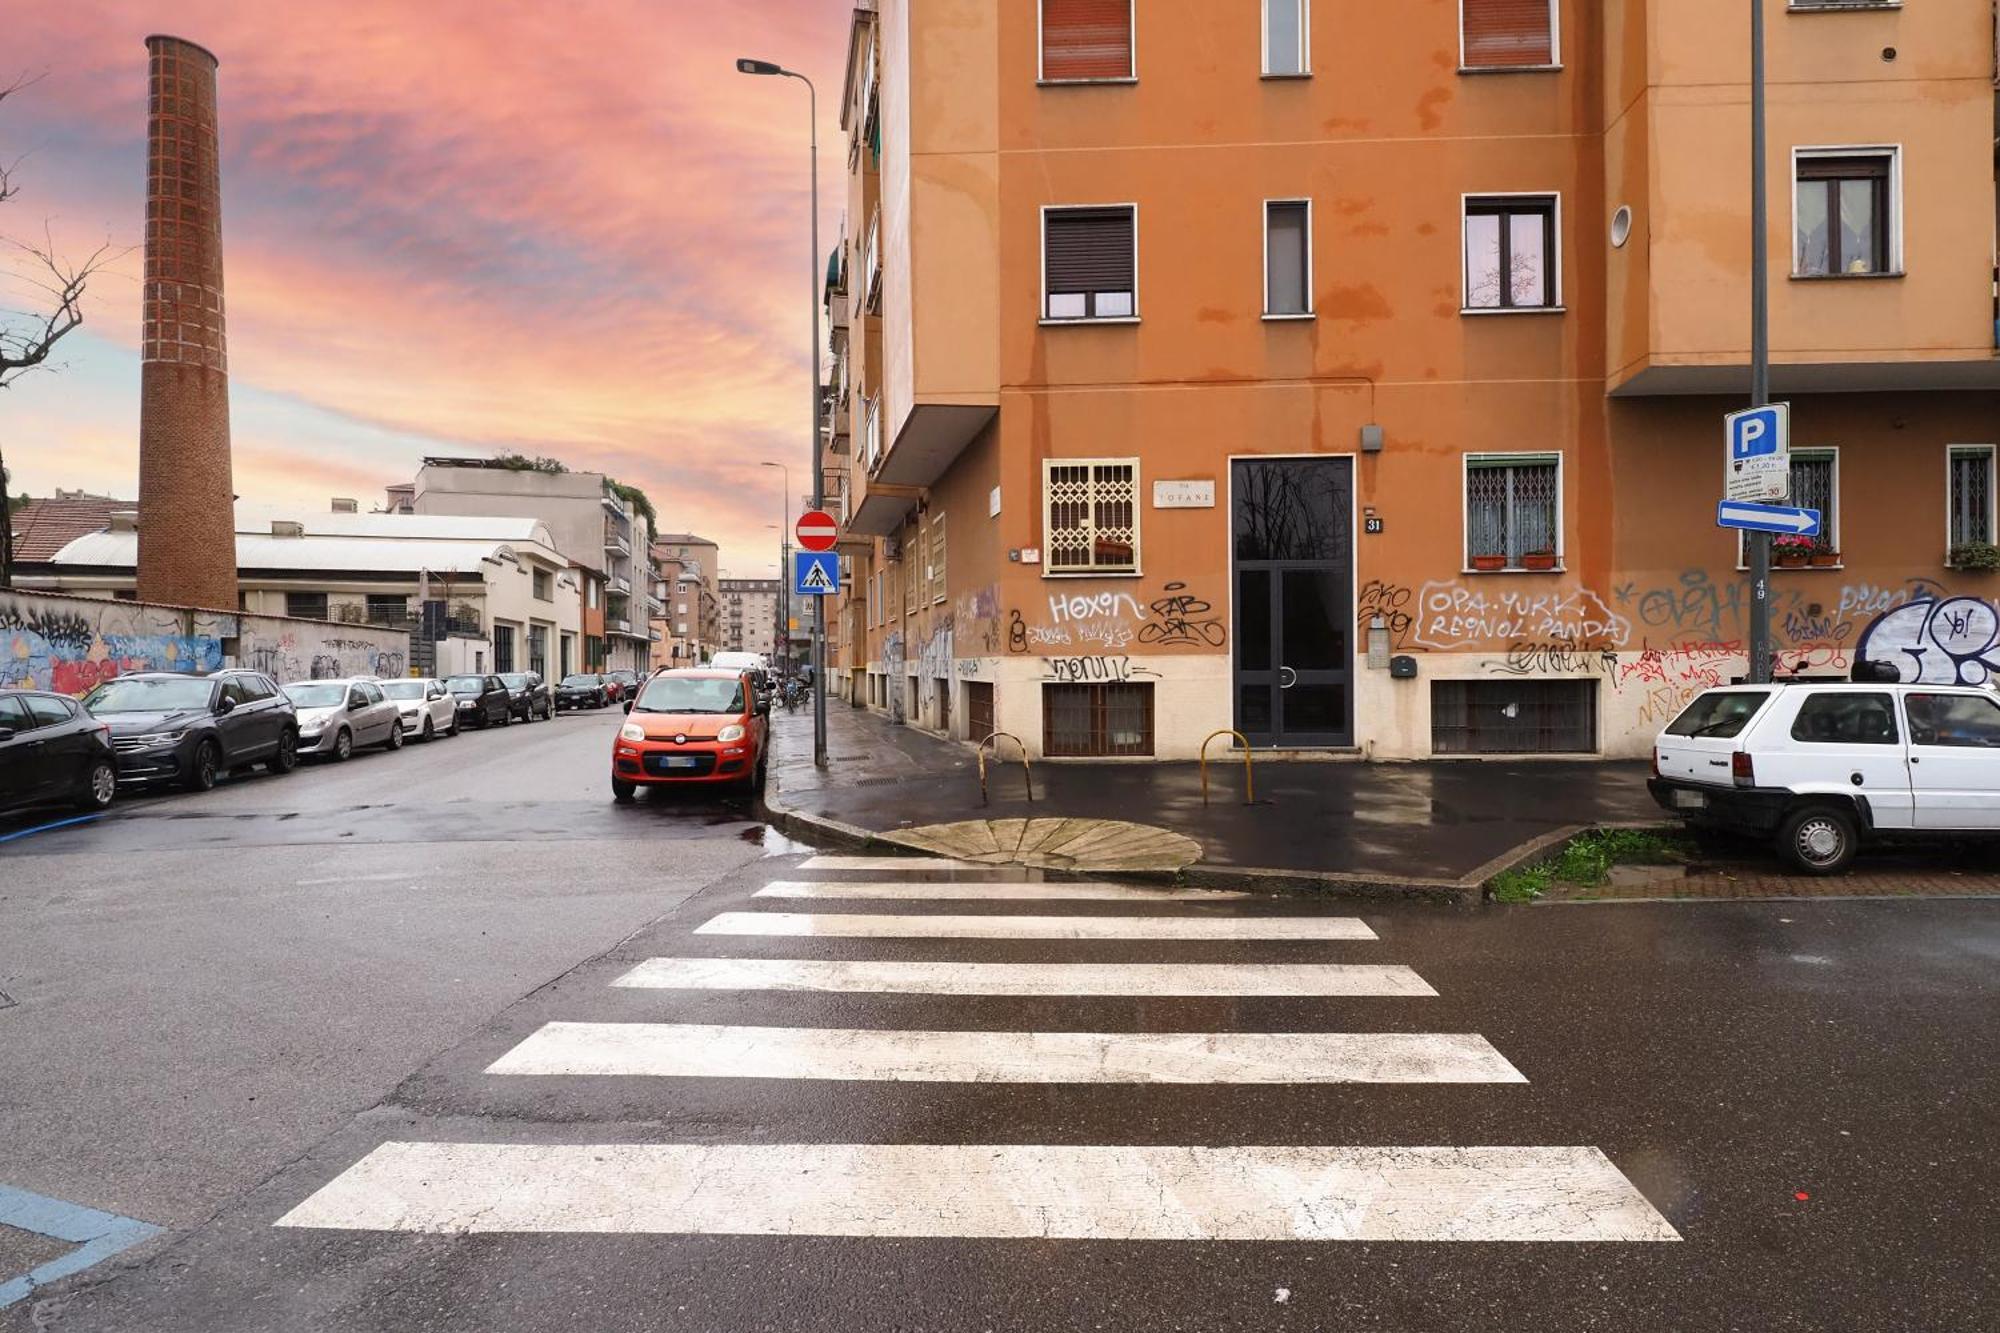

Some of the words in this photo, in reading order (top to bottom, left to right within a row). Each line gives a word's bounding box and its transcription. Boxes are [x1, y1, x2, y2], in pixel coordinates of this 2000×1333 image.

[1741, 418, 1765, 453] P
[1367, 519, 1381, 531] 31
[1537, 616, 1620, 639] PANDA
